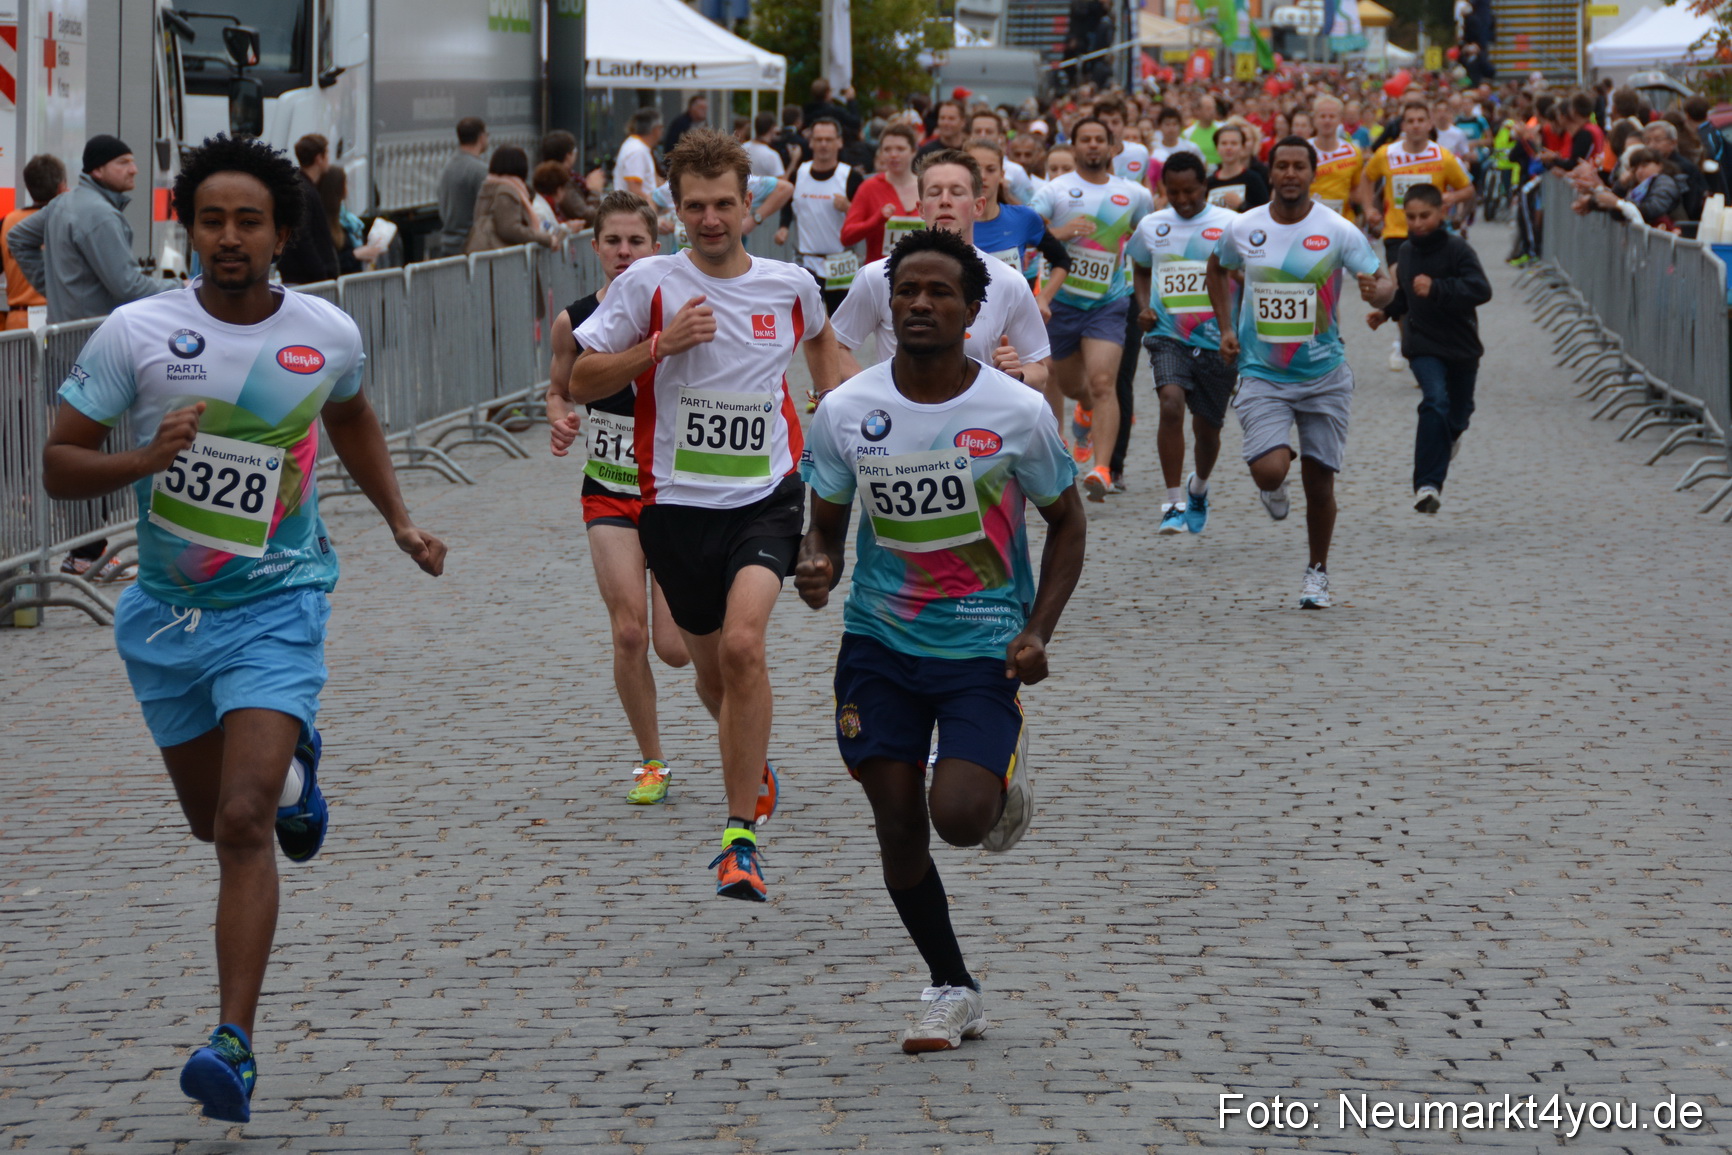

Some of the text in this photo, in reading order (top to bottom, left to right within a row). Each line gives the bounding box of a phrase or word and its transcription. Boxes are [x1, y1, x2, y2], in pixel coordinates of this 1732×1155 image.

[597, 60, 698, 82] Laufsport
[830, 258, 857, 277] 5032
[1070, 257, 1110, 281] 5399
[1164, 272, 1208, 294] 5327
[1274, 288, 1305, 296] Neumarkt
[1259, 297, 1308, 320] 5331
[283, 351, 320, 367] Hervis
[167, 364, 207, 374] PARTL
[681, 397, 761, 412] PARTL Neumarkt
[591, 417, 613, 429] PARTL
[686, 412, 765, 451] 5309
[857, 446, 890, 456] PARTL
[961, 434, 997, 451] Hervis
[202, 446, 262, 467] Neumarkt
[859, 461, 950, 476] PARTL Neumarkt
[165, 455, 267, 514] 5328
[870, 475, 966, 517] 5329
